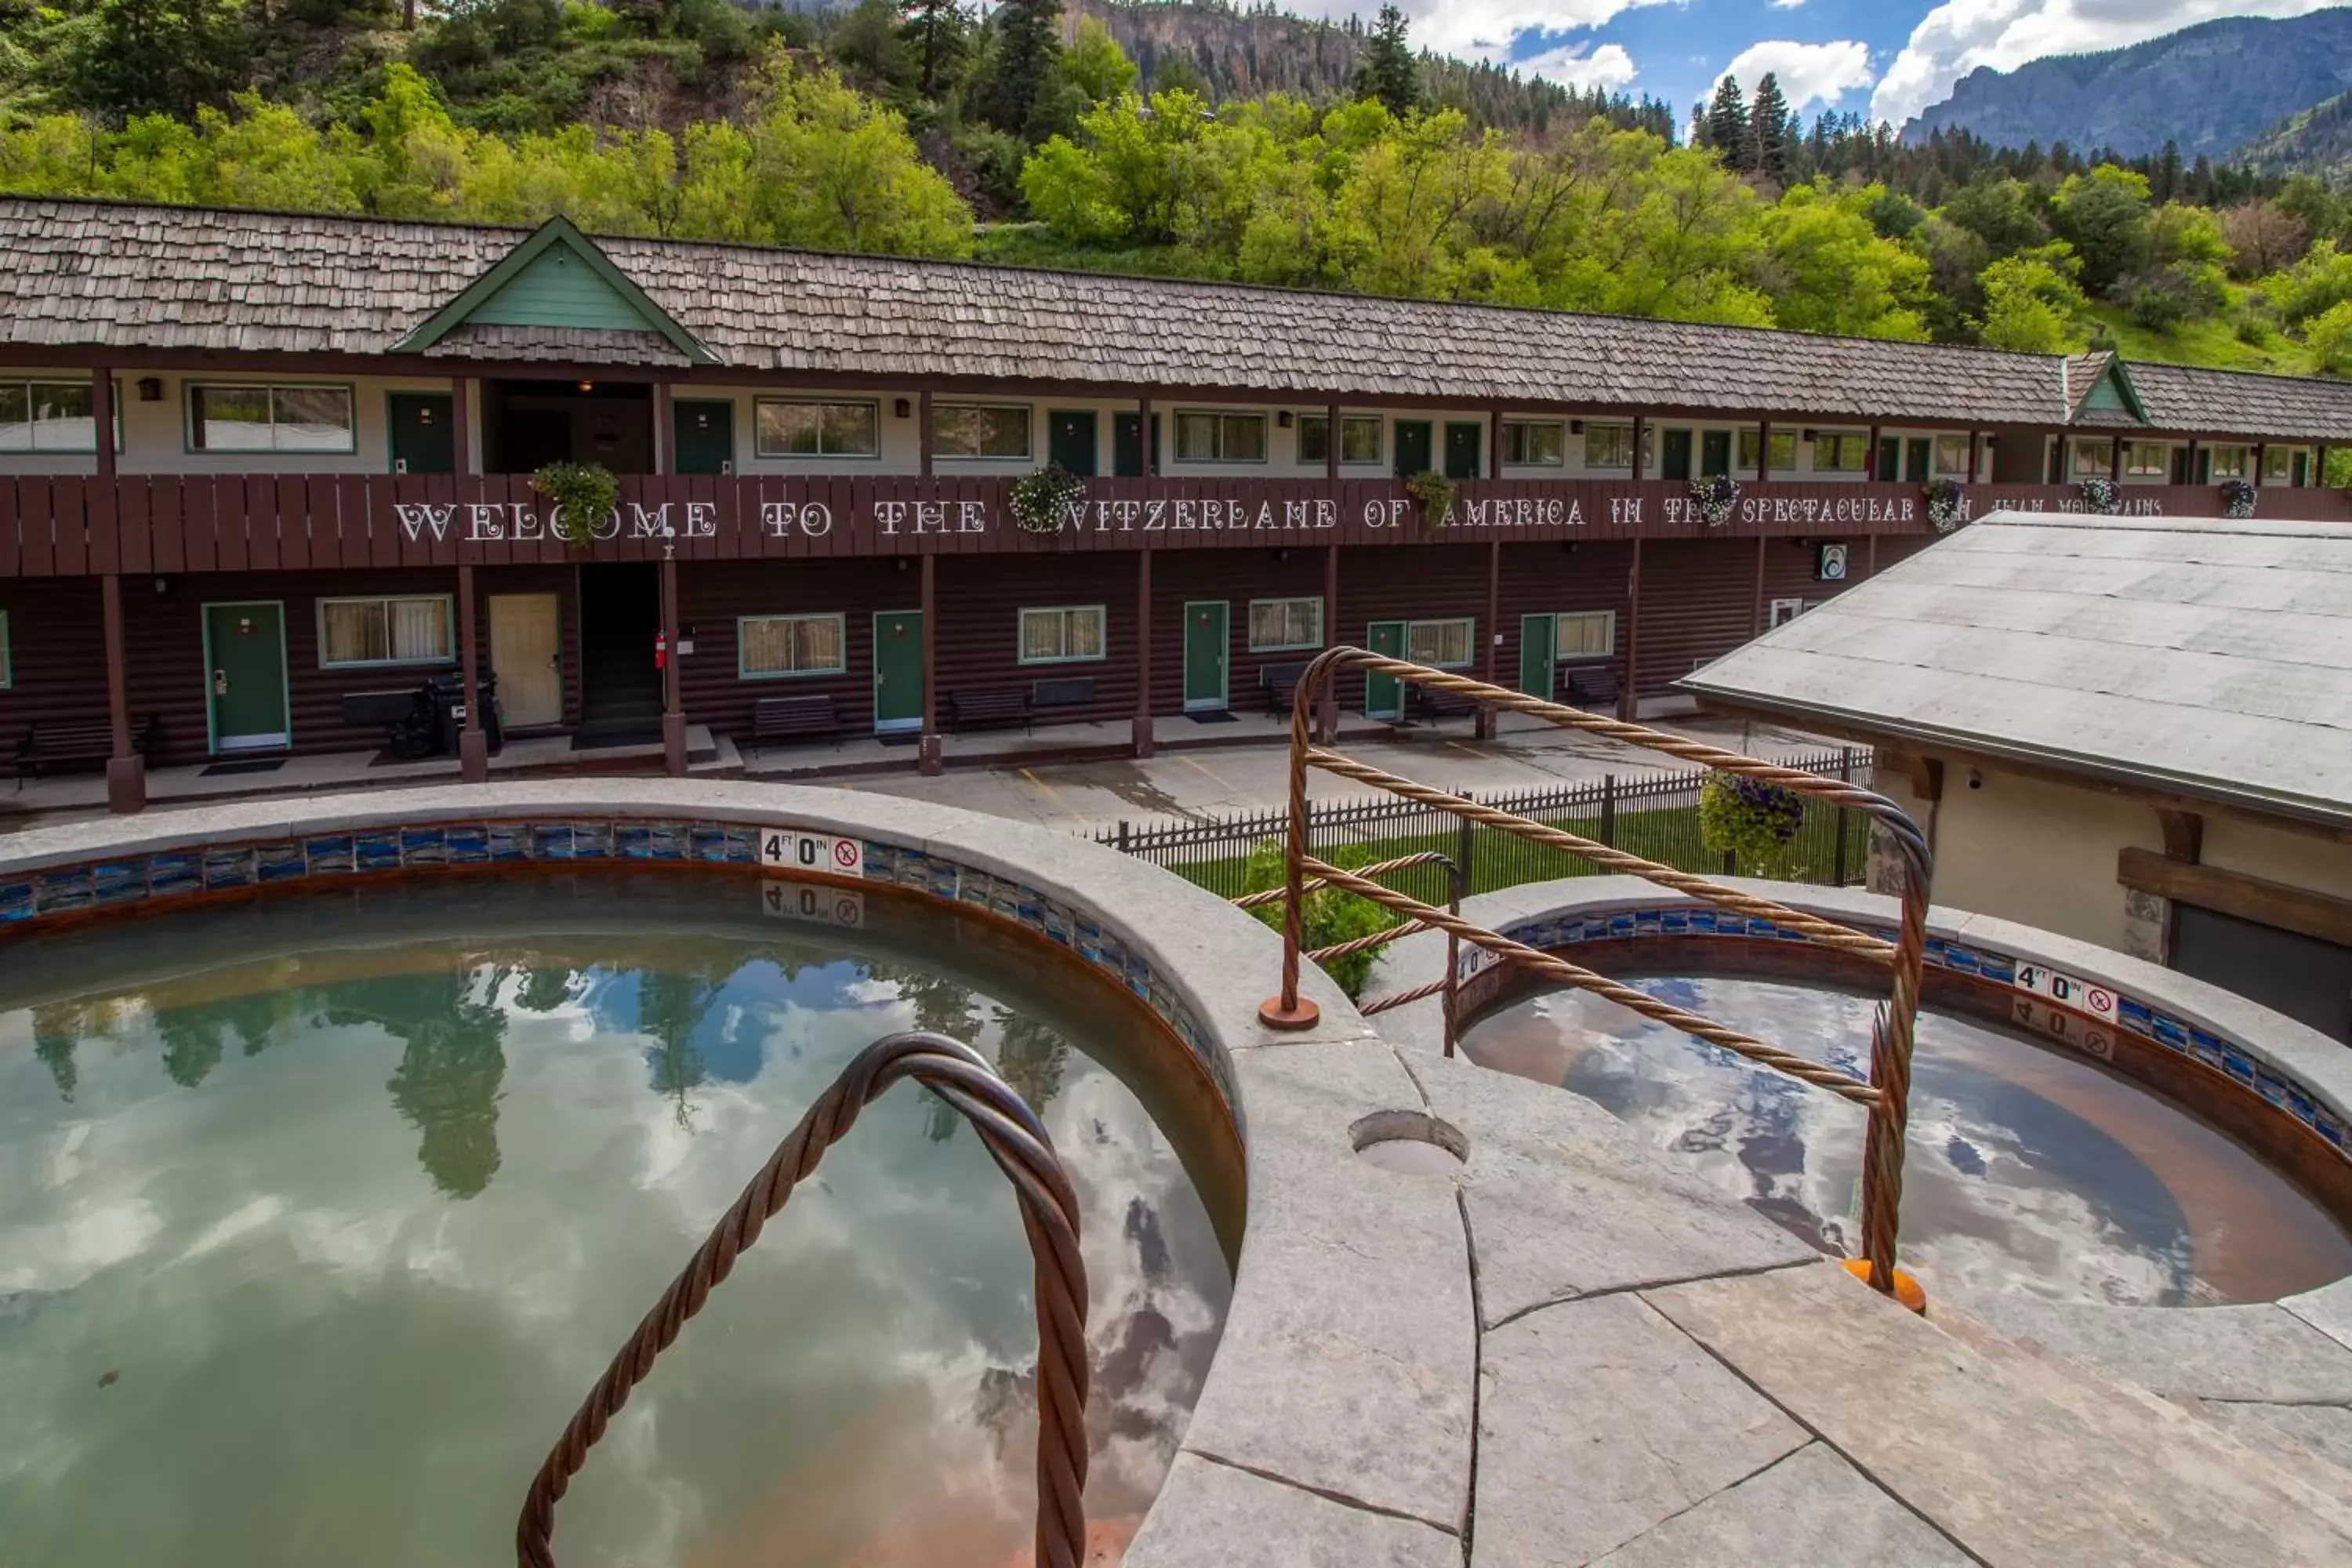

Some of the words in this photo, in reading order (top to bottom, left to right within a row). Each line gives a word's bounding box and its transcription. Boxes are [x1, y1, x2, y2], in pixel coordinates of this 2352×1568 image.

[394, 503, 717, 543] WELCOME
[761, 502, 832, 537] TO
[874, 501, 985, 534] THE
[1022, 500, 1338, 533] WITZERLAND
[1364, 499, 1411, 528] OF
[1436, 498, 1586, 528] AMERICA
[1610, 498, 1643, 524] IN
[1664, 498, 1706, 524] TH
[1741, 498, 1914, 523] SPECTACULAR
[764, 834, 782, 862] 4
[782, 836, 792, 845] FT
[799, 838, 815, 865] 0
[816, 840, 827, 851] IN
[2018, 966, 2035, 988] 4
[2053, 976, 2069, 999] 0
